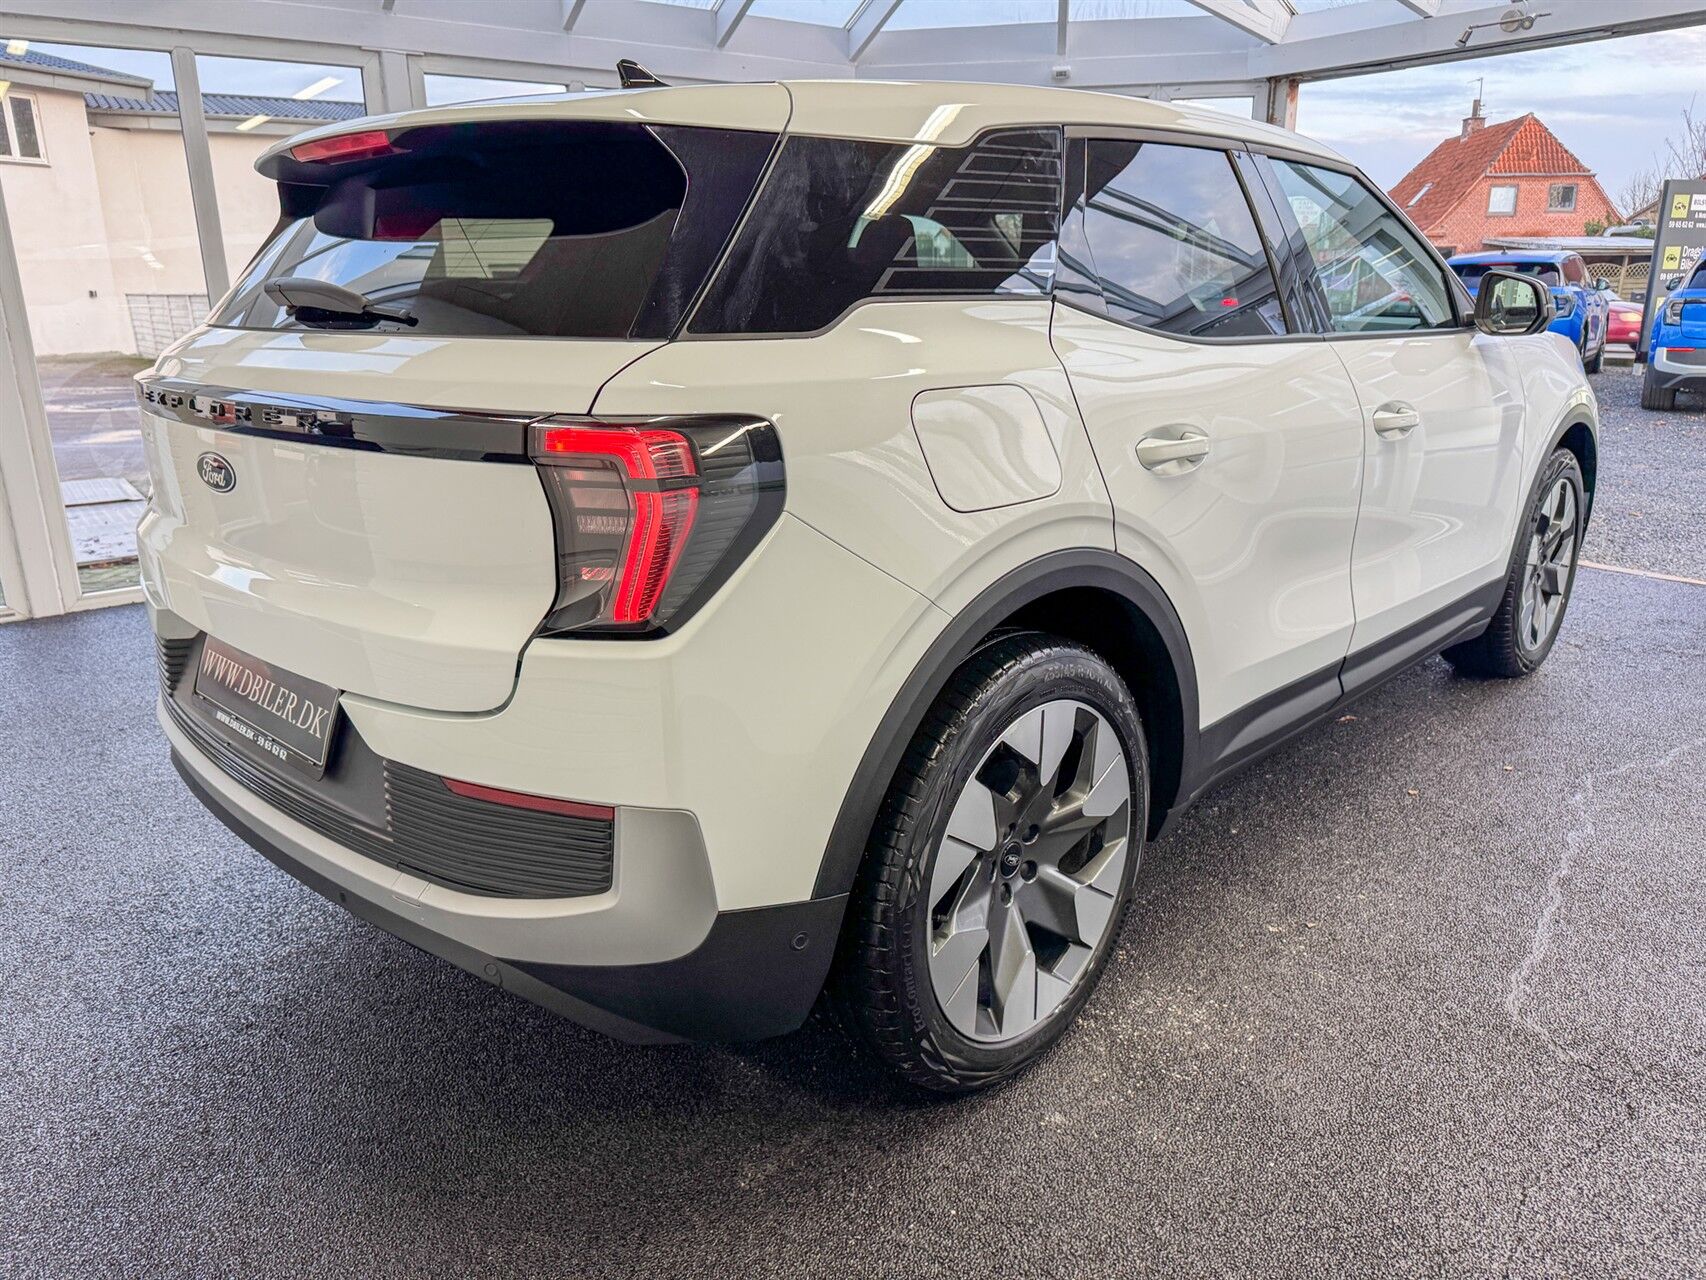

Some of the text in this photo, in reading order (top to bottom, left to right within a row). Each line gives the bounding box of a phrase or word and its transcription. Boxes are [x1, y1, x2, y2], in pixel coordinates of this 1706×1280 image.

[203, 649, 330, 739] WWW.DBILER.DK
[215, 710, 256, 743] WWW.DBILER.DK
[257, 734, 265, 747] 59
[279, 748, 288, 760] 62
